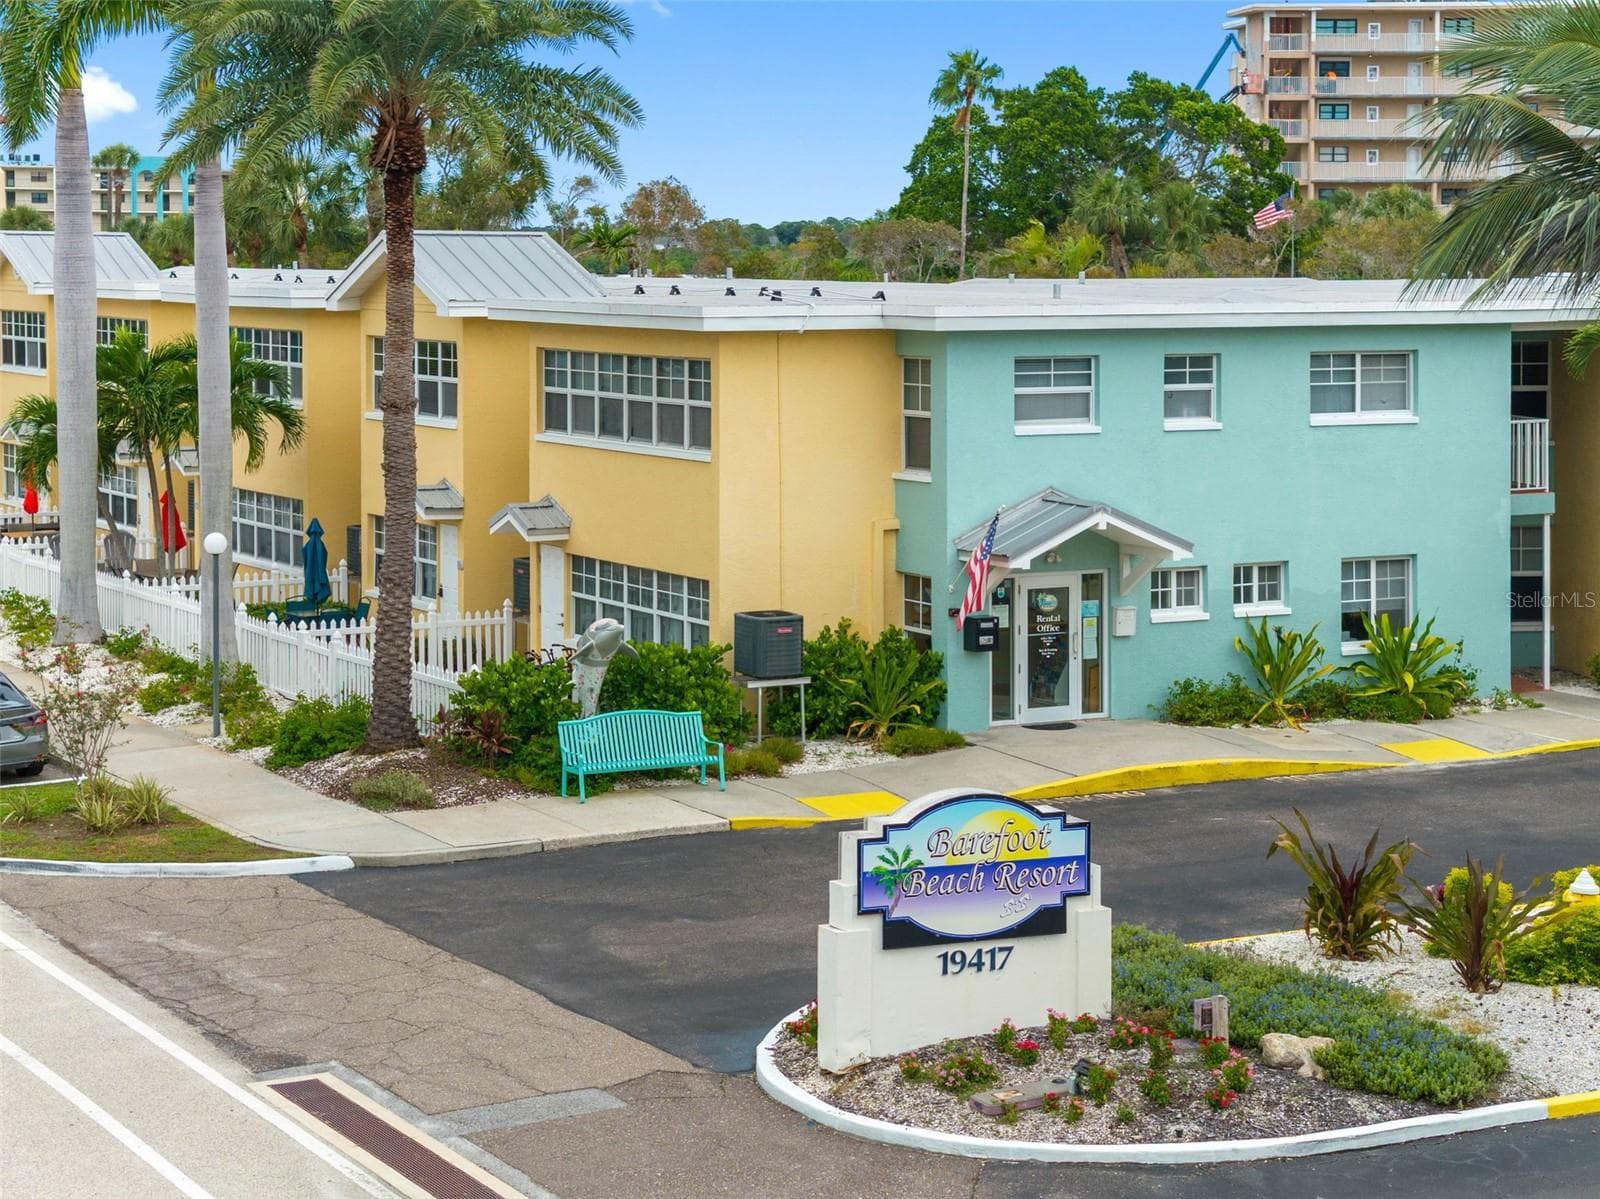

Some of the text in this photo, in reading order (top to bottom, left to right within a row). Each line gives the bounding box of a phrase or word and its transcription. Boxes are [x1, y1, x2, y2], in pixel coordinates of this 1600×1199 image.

[1036, 614, 1061, 623] Rental
[1036, 624, 1060, 632] Office
[927, 819, 1052, 864] Barefoot
[901, 861, 1080, 898] Beach Resort
[937, 946, 1015, 976] 19417
